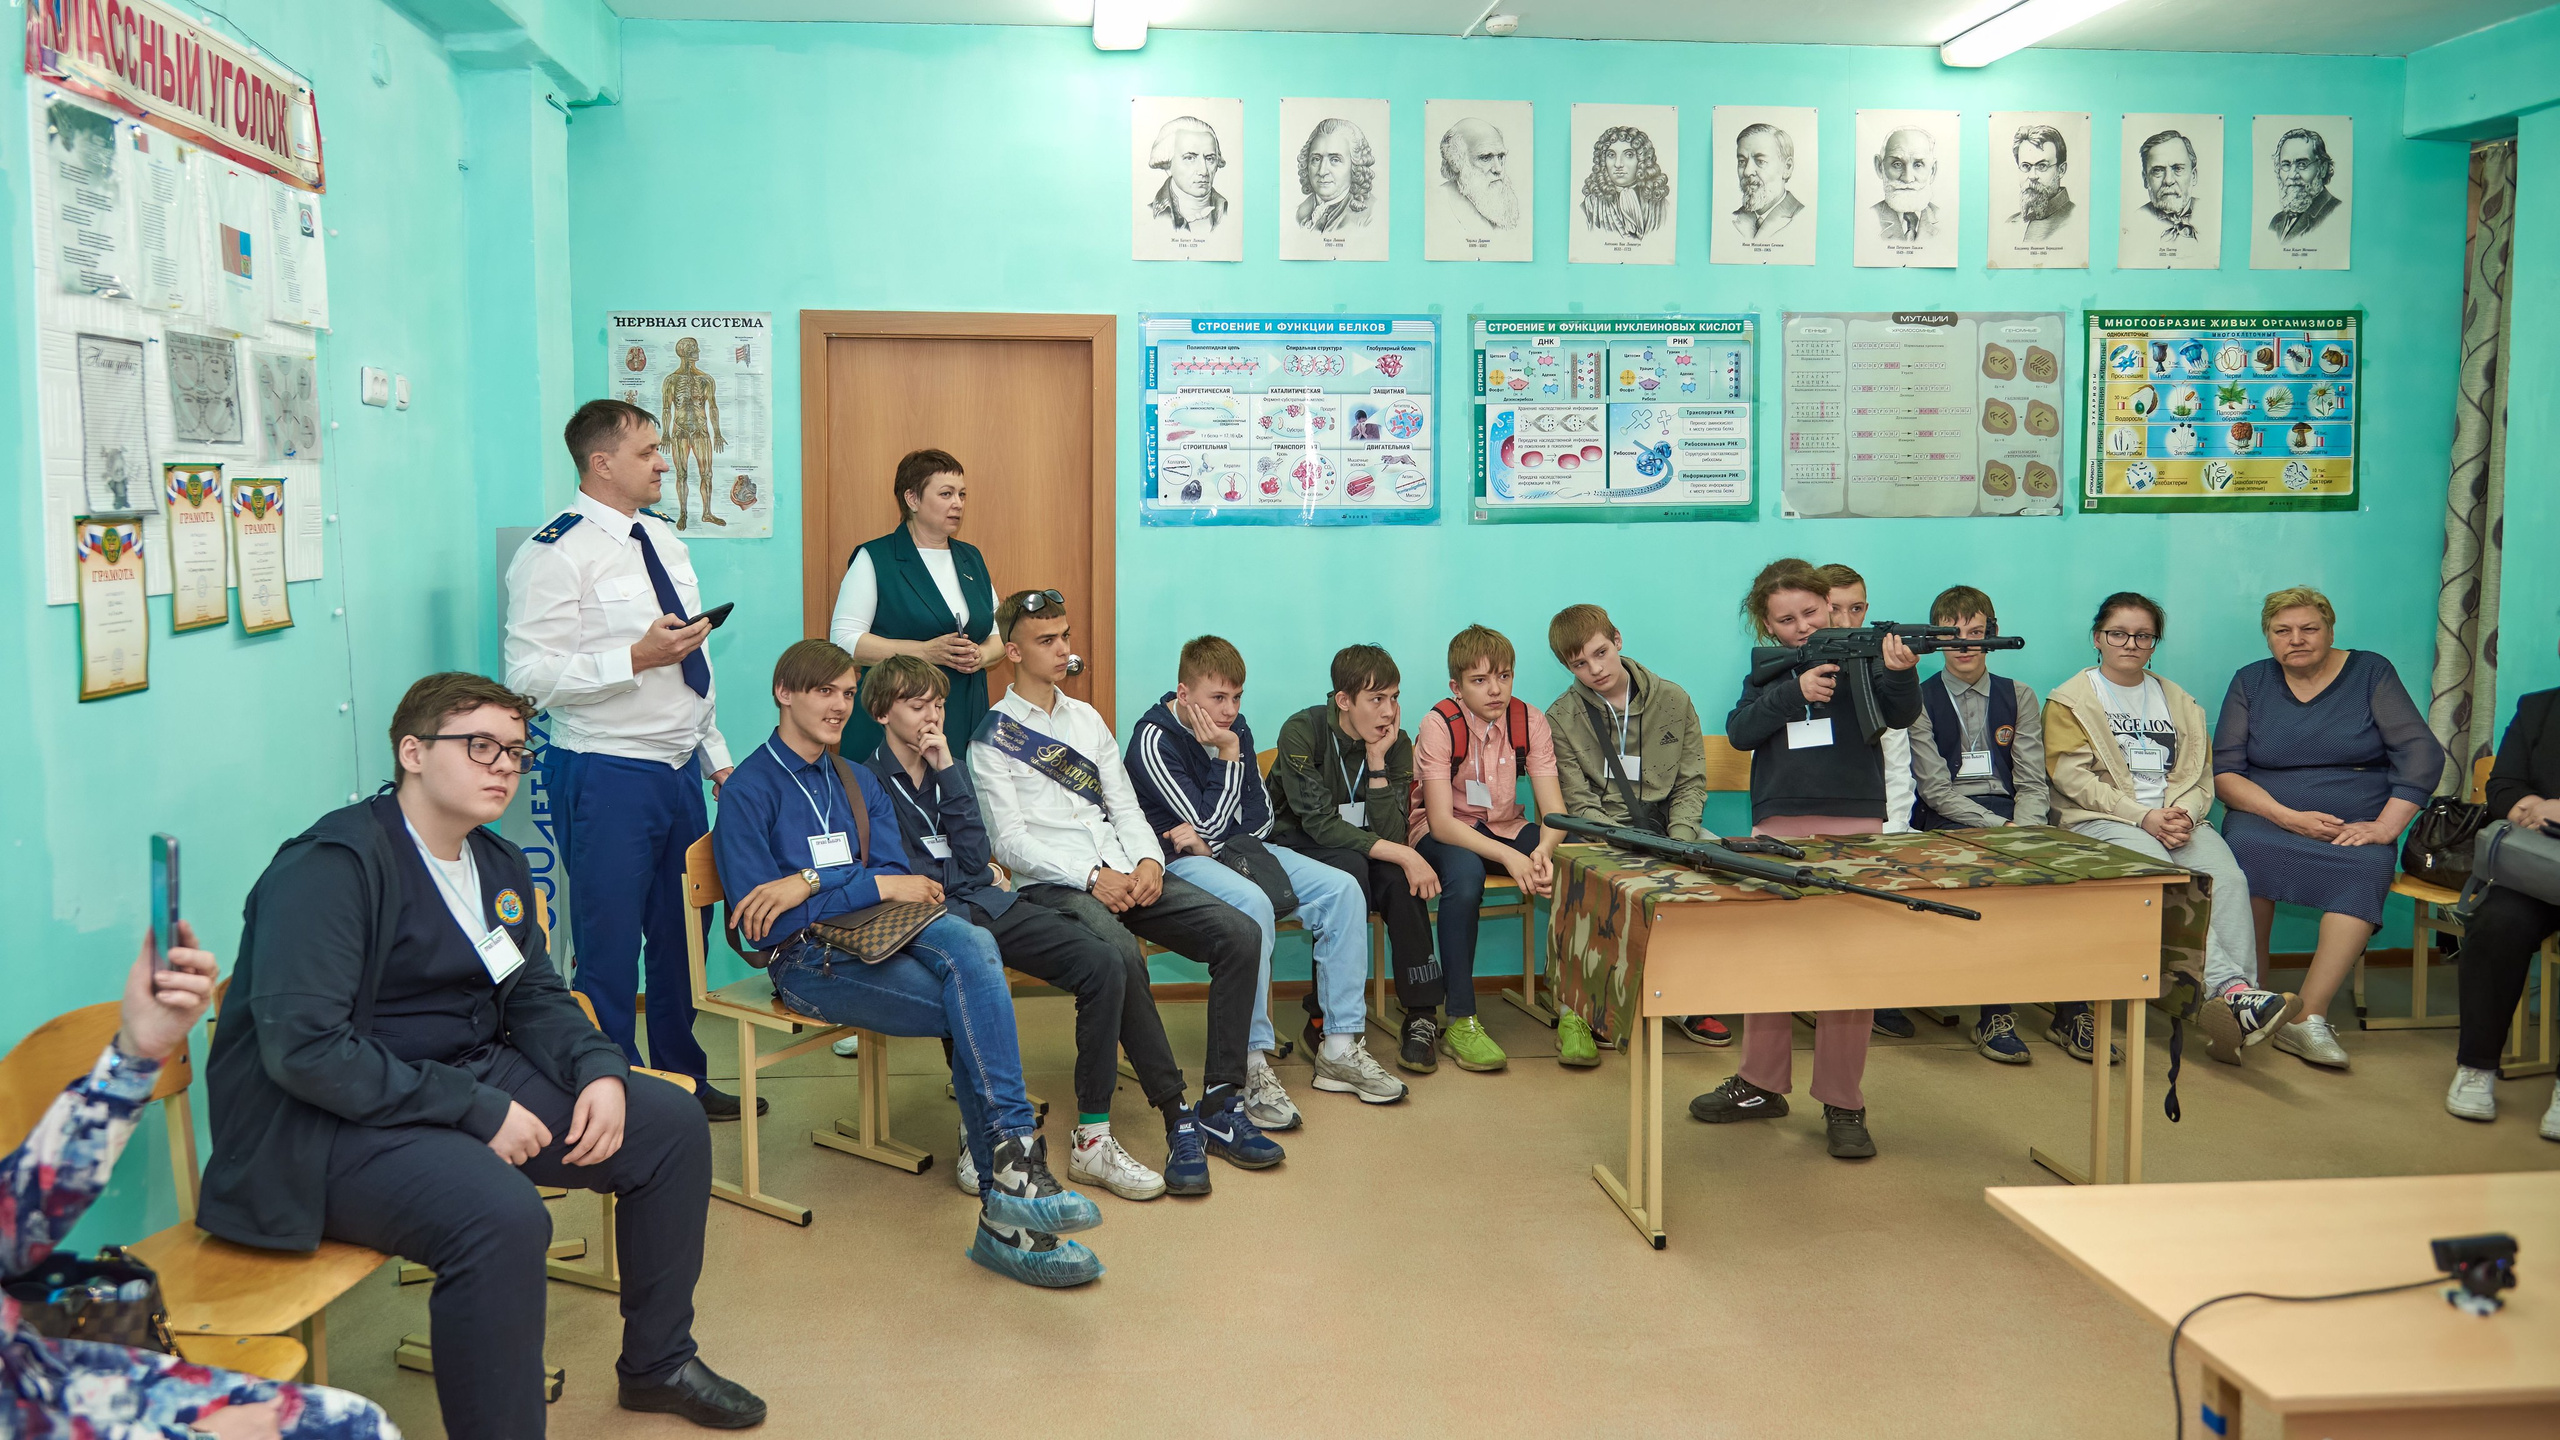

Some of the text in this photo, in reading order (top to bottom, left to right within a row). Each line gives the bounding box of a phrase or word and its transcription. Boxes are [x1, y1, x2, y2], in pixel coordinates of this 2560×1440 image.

[207, 49, 291, 160] УГОЛОК
[615, 317, 764, 328] НЕРВНАЯ СИСТЕМА
[1900, 315, 1949, 323] МУТАЦИИ
[2105, 319, 2343, 328] МНОГООБРАЗИЕ ЖИВЫХ ОРГАНИЗМОВ
[1198, 322, 1386, 332] СТРОЕНИЕ И ФУНКЦИИ БЕЛКОВ
[1488, 323, 1742, 333] СТРОЕНИЕ И ФУНКЦИИ НУКЛЕИНОВЫХ КИСЛОТ
[179, 511, 216, 525] ГРАМОТА
[244, 523, 277, 535] ГРАМОТА
[92, 568, 136, 583] ГРАМОТА
[1660, 738, 1679, 746] adidas
[1180, 1122, 1192, 1130] NIKE
